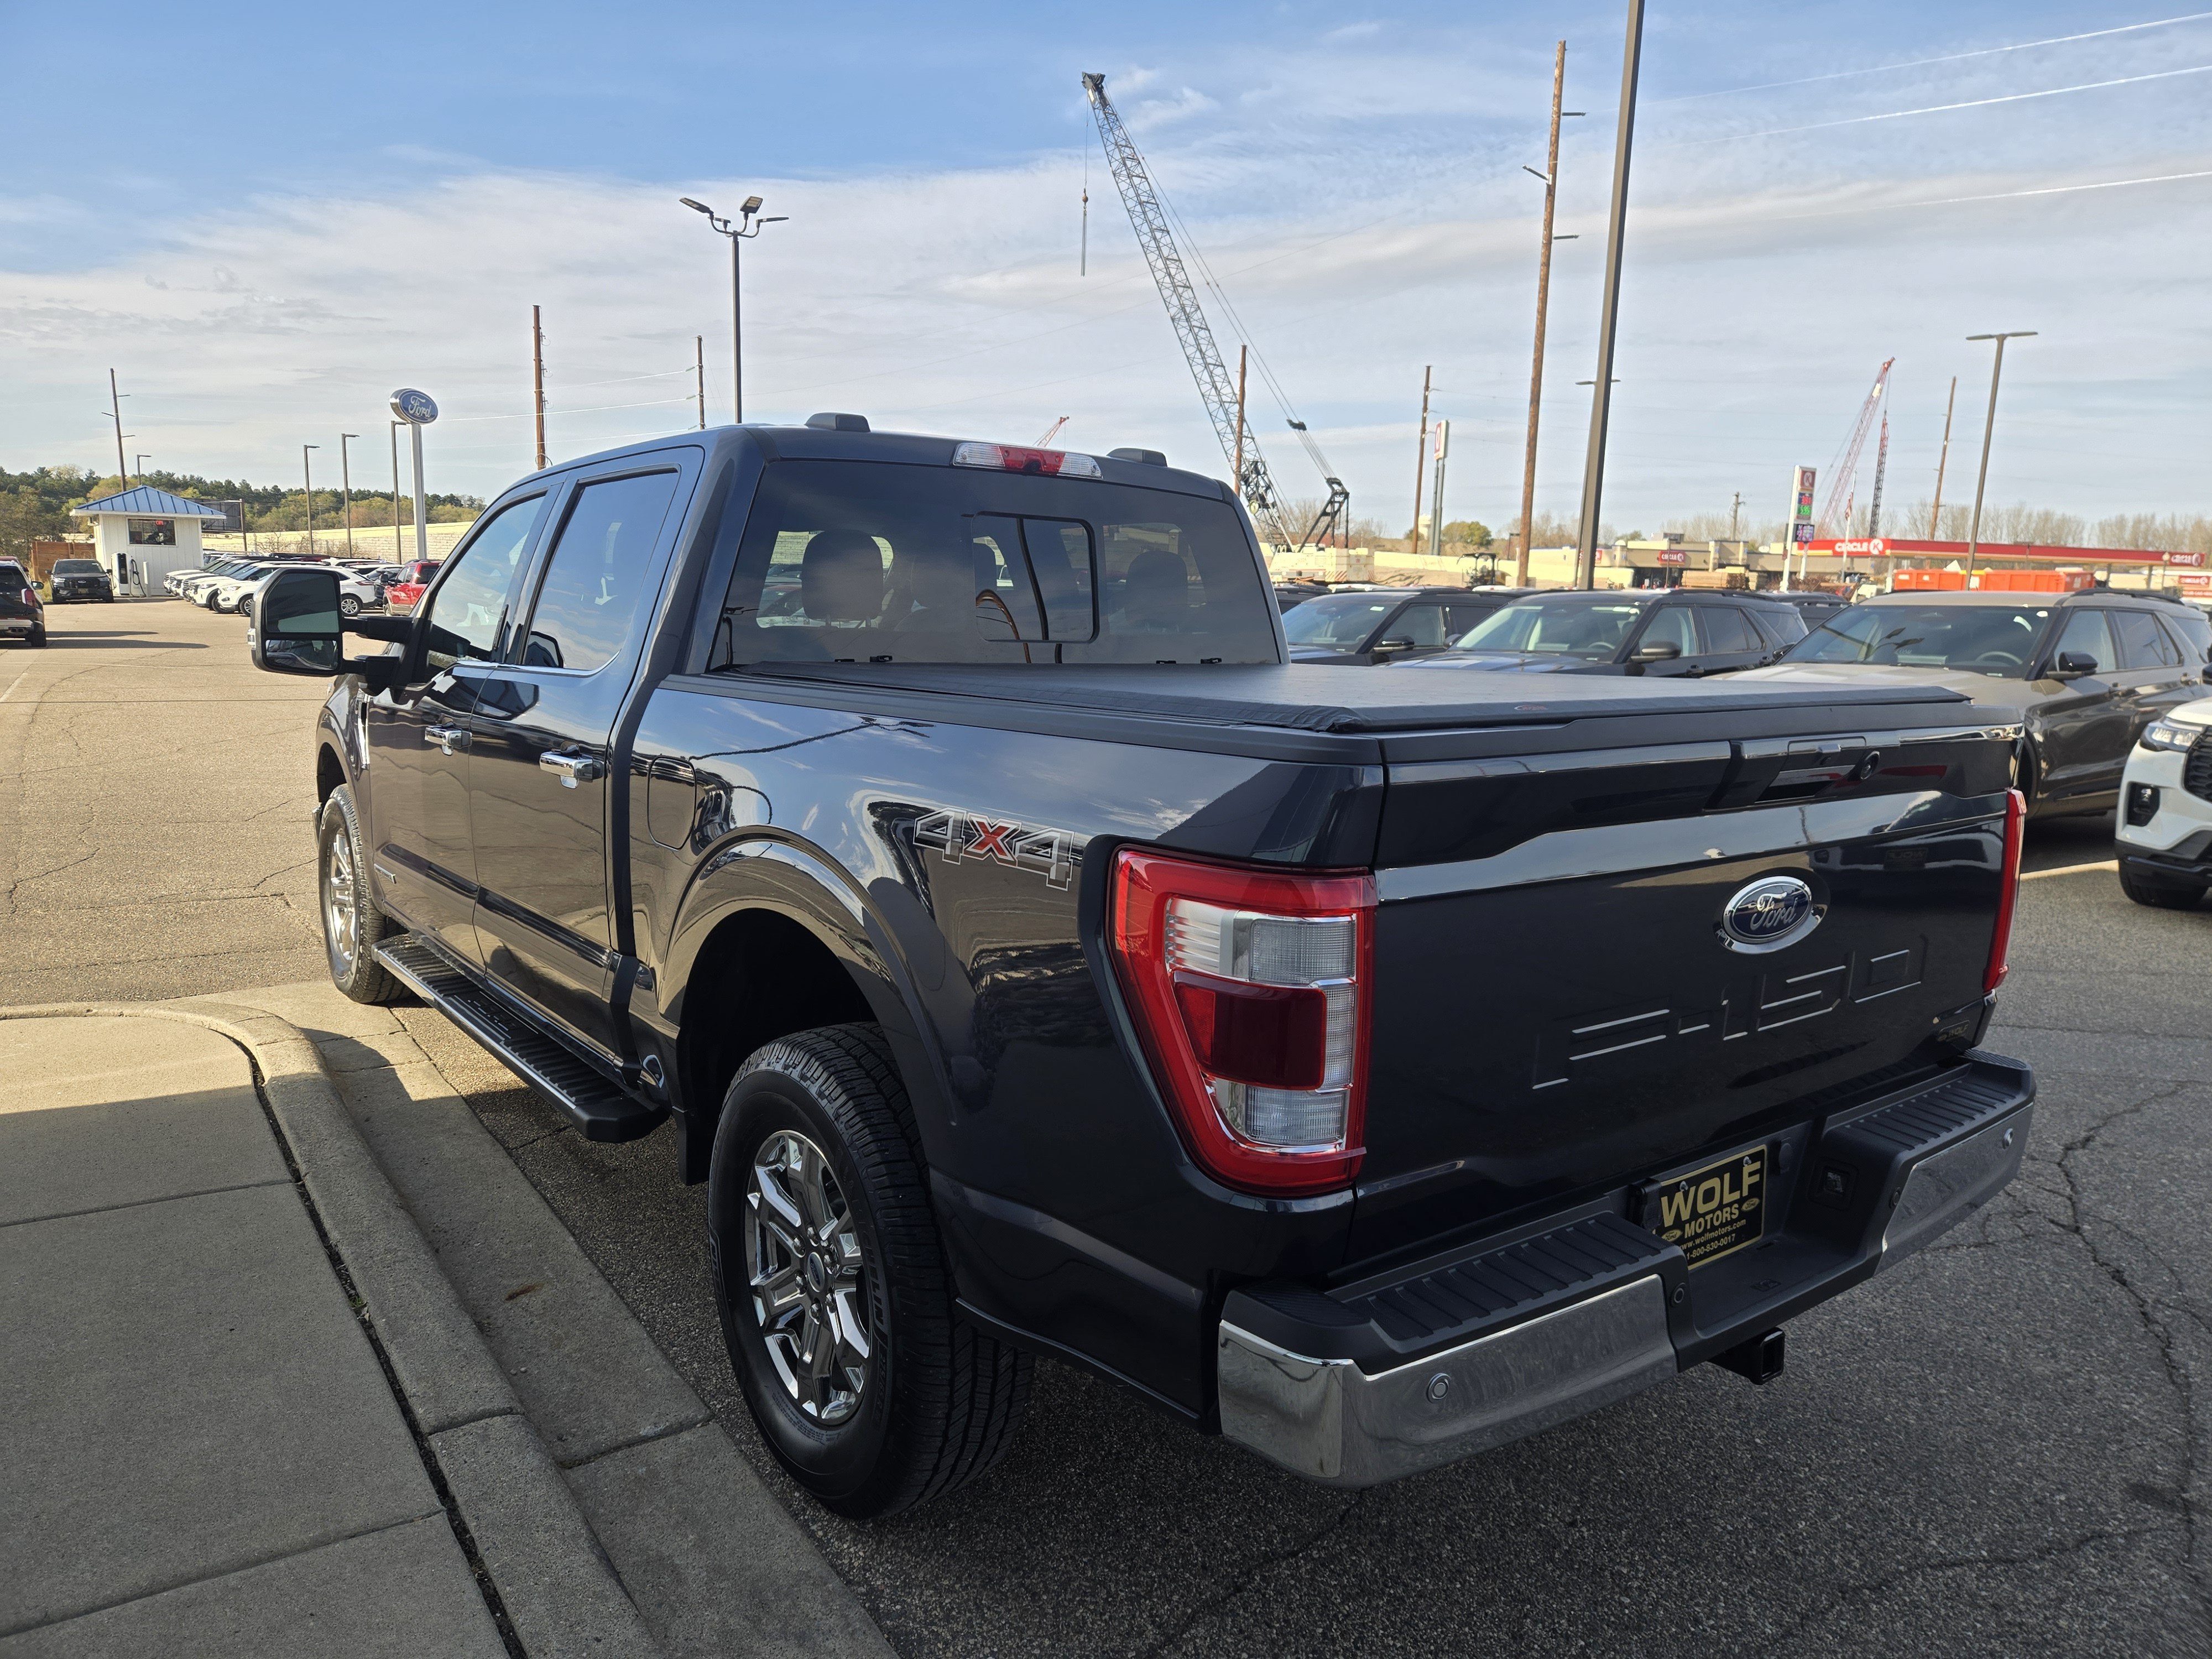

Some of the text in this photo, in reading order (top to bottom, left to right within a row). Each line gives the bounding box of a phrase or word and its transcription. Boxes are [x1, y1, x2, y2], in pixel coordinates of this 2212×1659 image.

[408, 395, 432, 418] Ford
[1870, 539, 1884, 555] K
[1750, 891, 1798, 930] Ford
[1532, 935, 1927, 1089] F-150
[1661, 1161, 1761, 1228] WOLF
[1681, 1219, 1746, 1250] ww.wolfmotors.com
[1684, 1203, 1739, 1239] MOTORS
[1687, 1233, 1736, 1260] 1-800-830-0017
